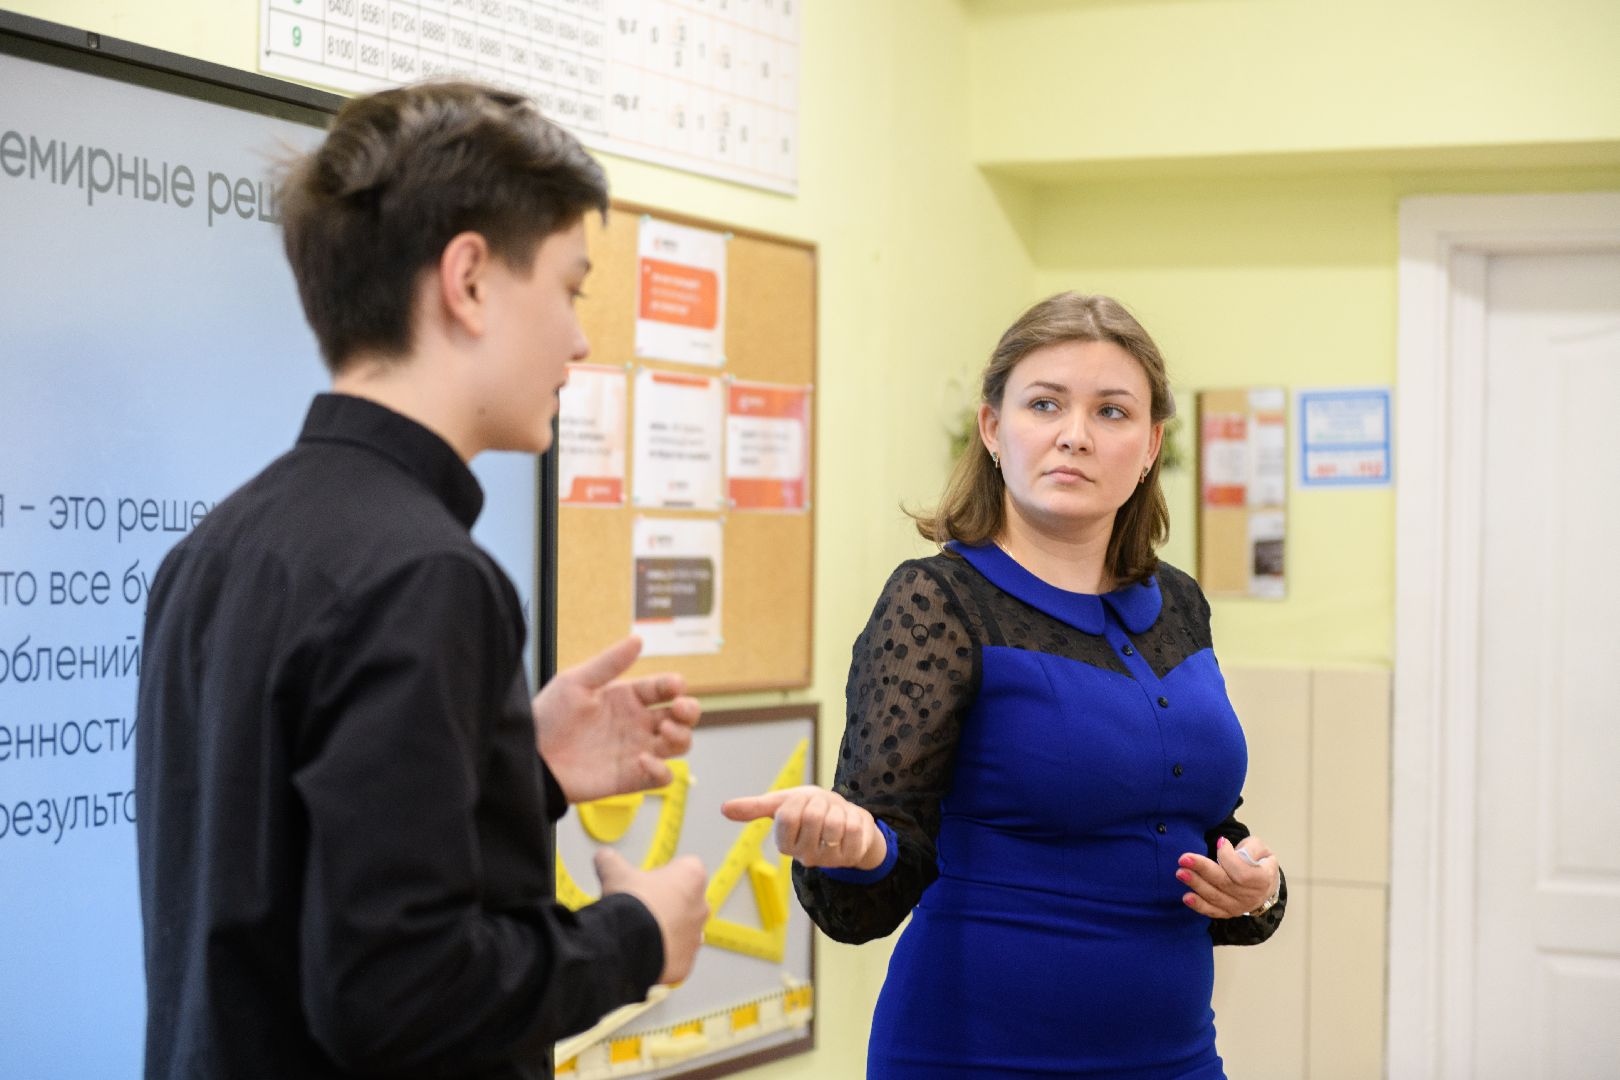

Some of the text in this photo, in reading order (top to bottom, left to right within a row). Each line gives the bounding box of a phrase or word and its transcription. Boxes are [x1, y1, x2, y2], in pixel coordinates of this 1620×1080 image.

[291, 25, 303, 48] 9
[0, 130, 195, 208] емирные
[49, 495, 106, 530] это
[50, 571, 111, 605] все
